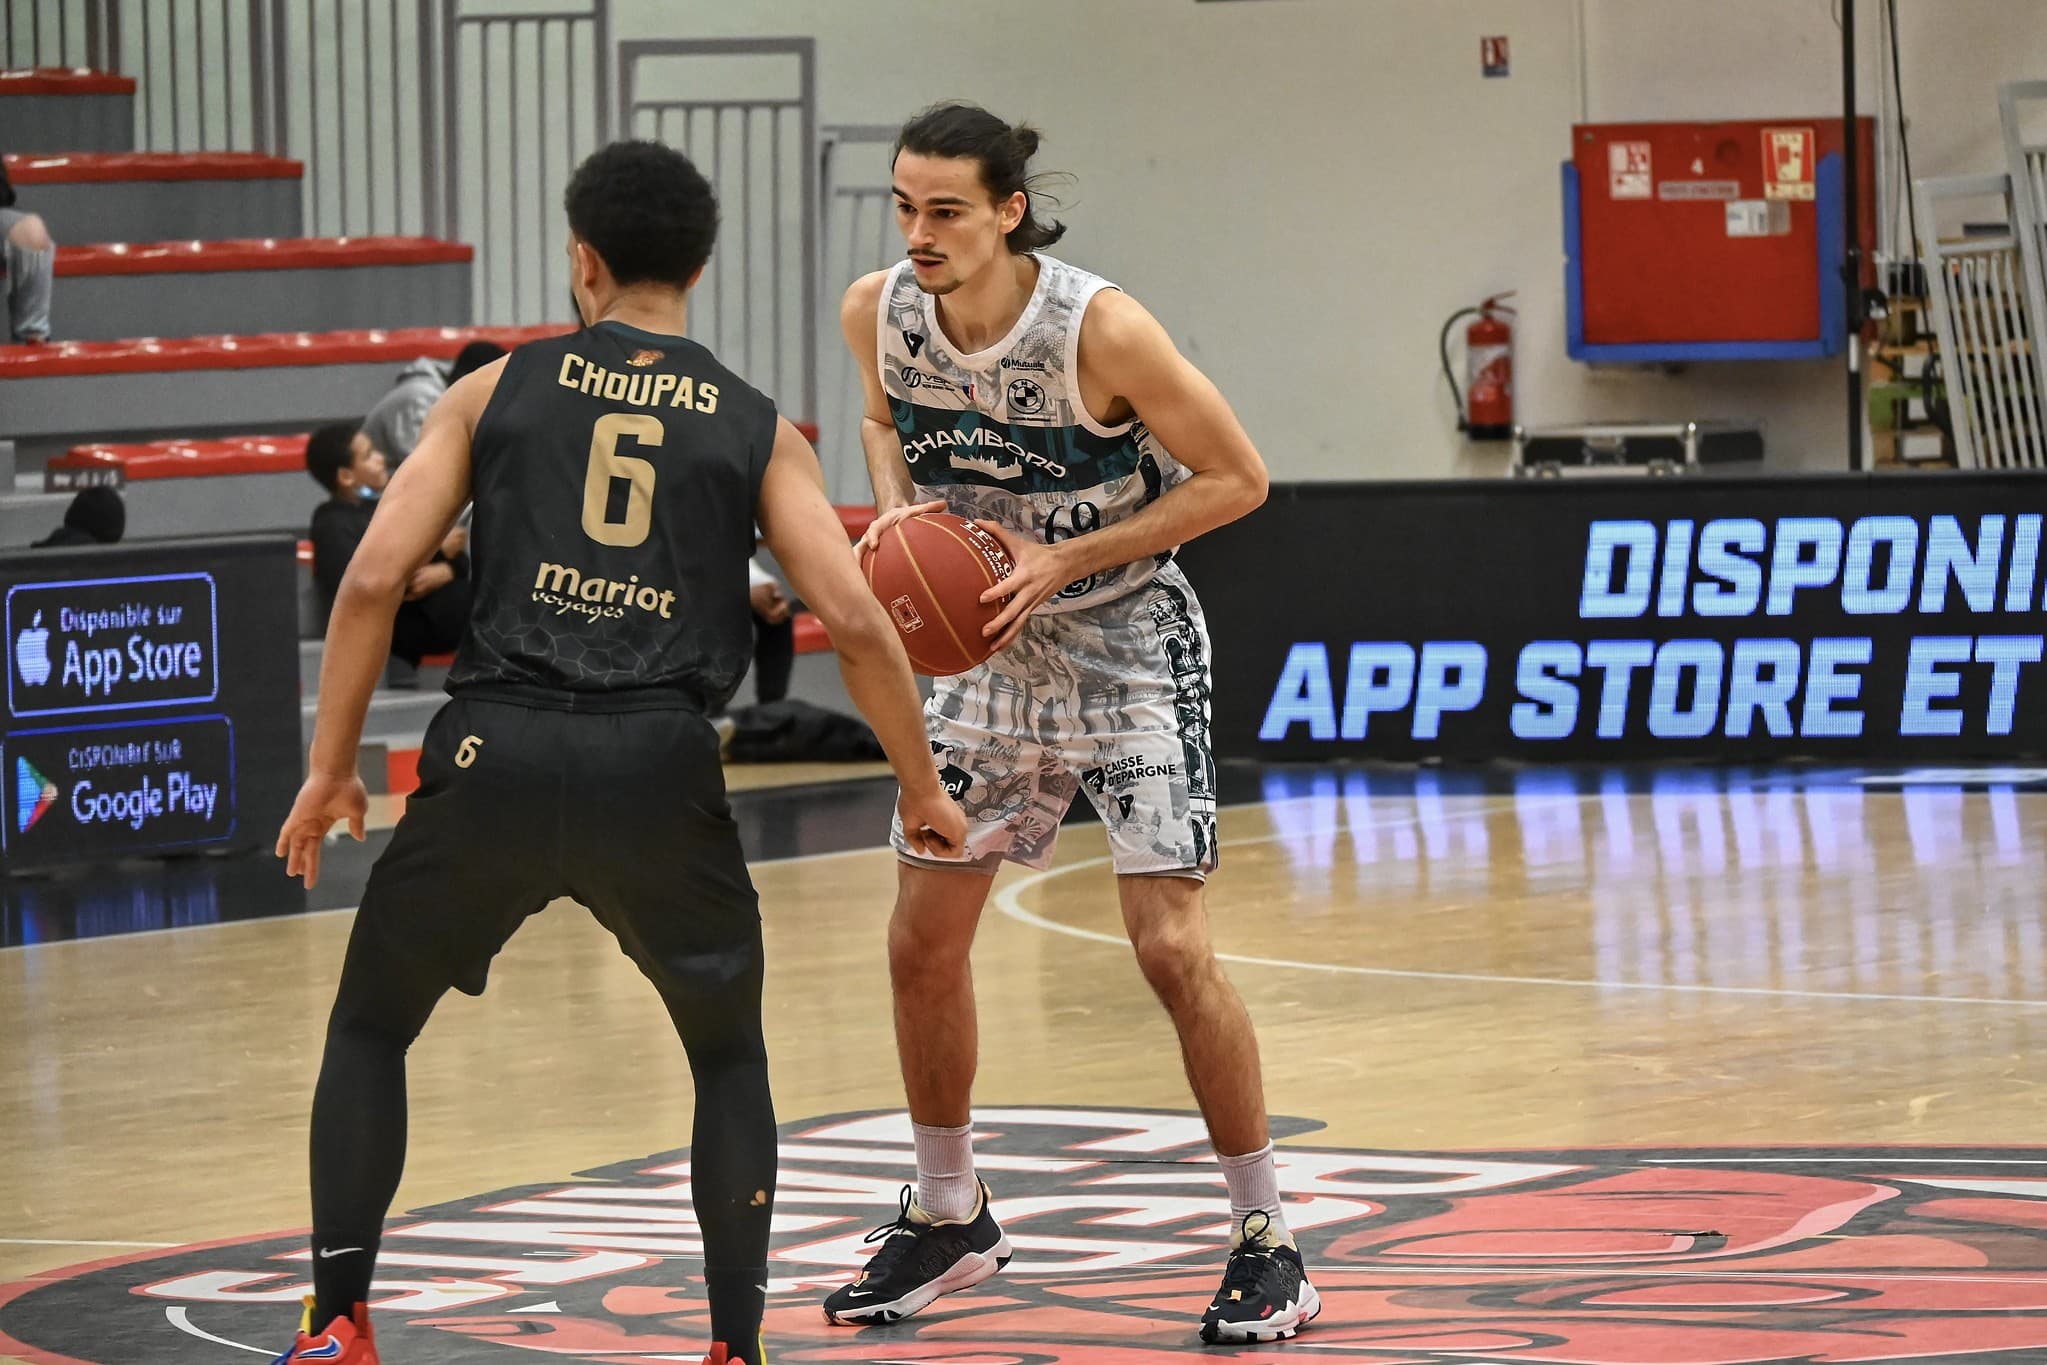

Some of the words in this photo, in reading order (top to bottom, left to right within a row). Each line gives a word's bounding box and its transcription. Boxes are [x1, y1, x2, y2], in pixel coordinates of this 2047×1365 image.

[558, 352, 720, 415] CHOUPAS
[581, 413, 665, 548] 6
[903, 428, 1067, 479] CHAMBORD
[535, 562, 676, 619] mariot
[1579, 513, 2047, 618] DISPONI
[60, 602, 151, 638] Disponible
[532, 591, 625, 624] voyages
[62, 640, 123, 697] App
[127, 633, 202, 682] Store
[1259, 641, 1488, 741] APP
[1509, 636, 1873, 741] STORE
[1898, 634, 2044, 737] ET
[454, 735, 484, 769] 6
[1105, 754, 1145, 775] CAISSE
[1108, 764, 1177, 786] D'EPARGNE
[72, 775, 164, 830] Google
[167, 771, 218, 820] Play
